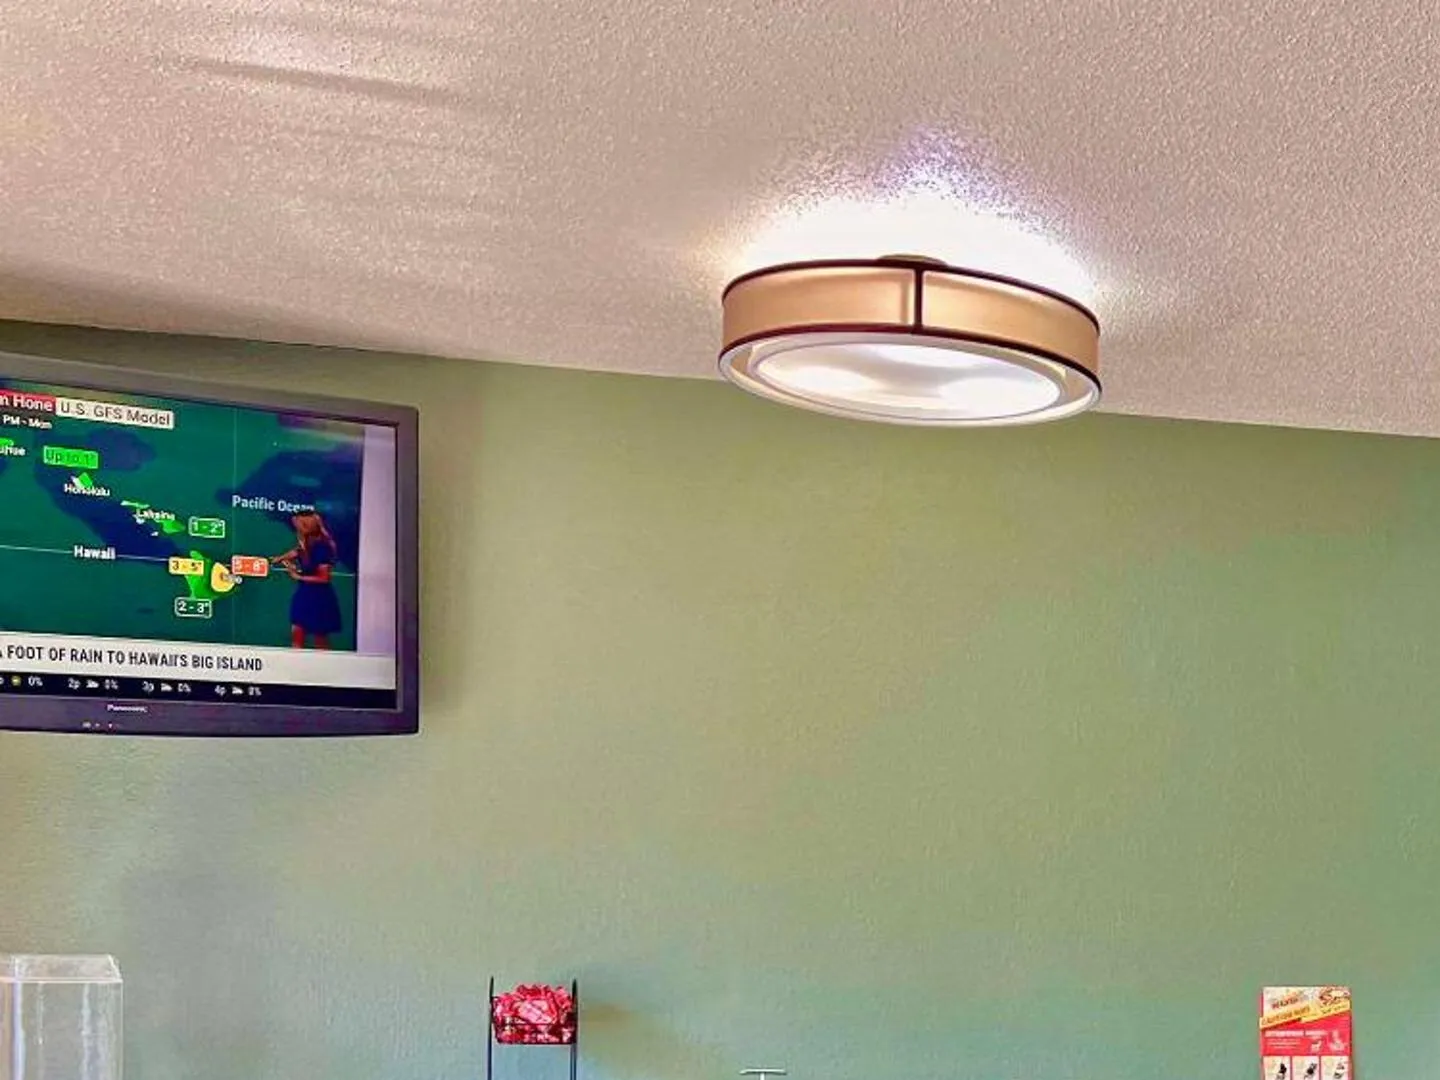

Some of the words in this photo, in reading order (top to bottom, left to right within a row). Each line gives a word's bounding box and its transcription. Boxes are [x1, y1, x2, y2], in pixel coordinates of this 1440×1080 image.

[13, 393, 53, 411] Hone
[3, 414, 20, 425] PM
[60, 402, 89, 416] U.S.
[93, 405, 122, 420] GFS
[126, 409, 170, 426] Model
[64, 483, 110, 496] Honolulu
[232, 495, 275, 511] Pacific
[74, 545, 116, 560] Hawaii
[7, 644, 44, 660] FOOT
[49, 647, 66, 661] OF
[70, 648, 103, 663] RAIN
[107, 651, 125, 664] TO
[192, 655, 213, 669] BIG
[217, 656, 263, 670] ISLAND
